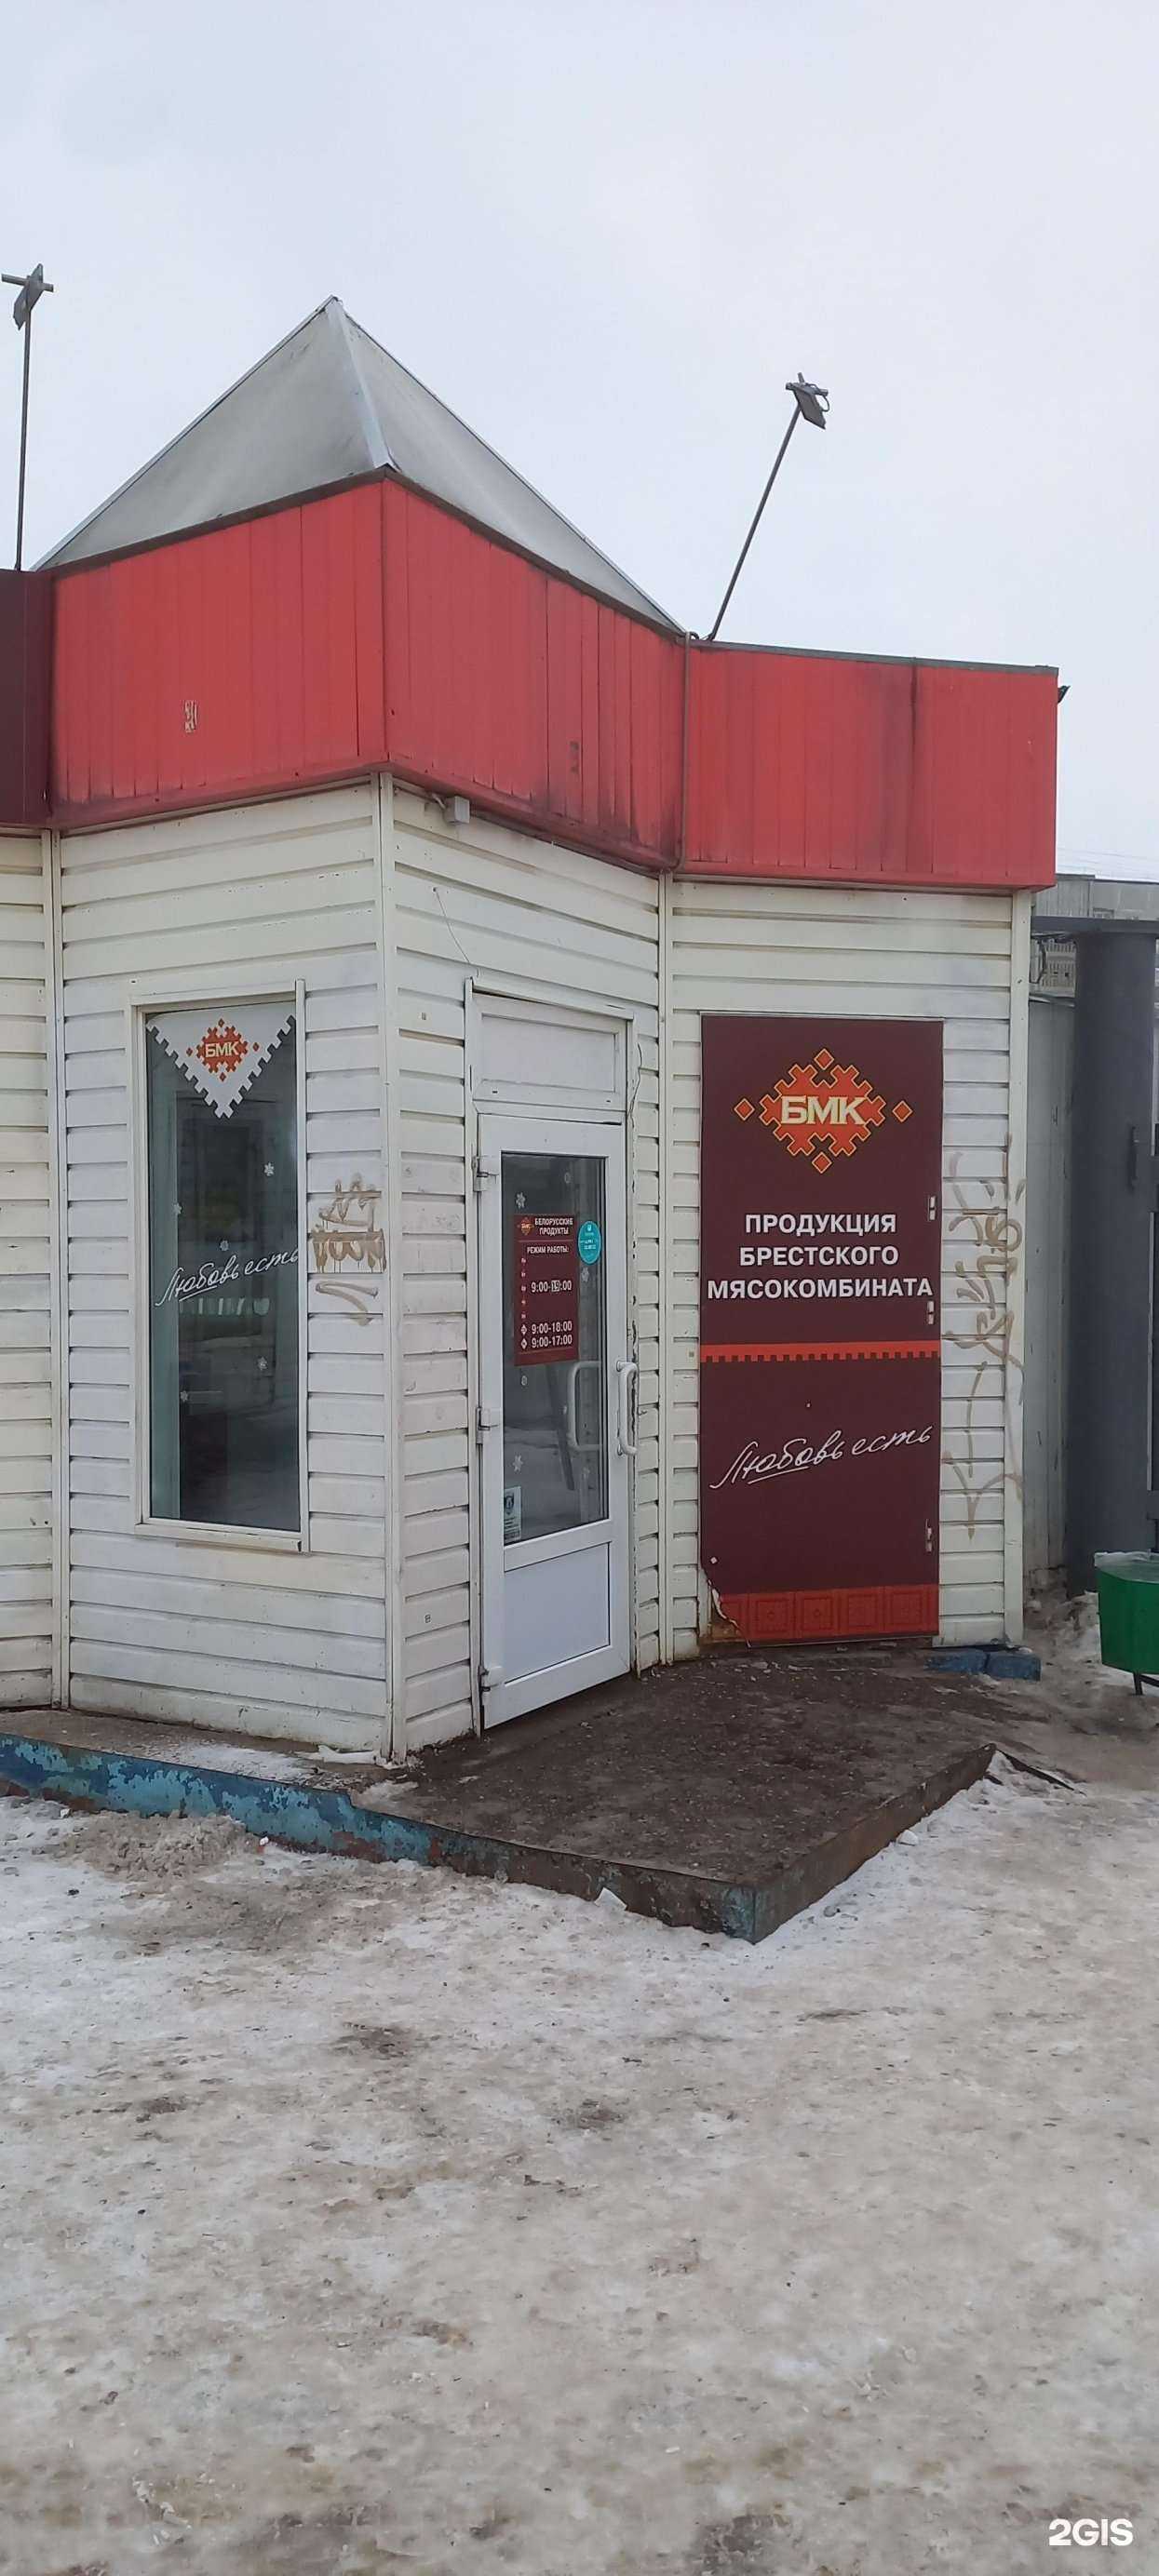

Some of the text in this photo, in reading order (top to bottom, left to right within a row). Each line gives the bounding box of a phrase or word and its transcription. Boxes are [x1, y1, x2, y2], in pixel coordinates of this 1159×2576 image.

[205, 1040, 240, 1058] БМК
[780, 1095, 867, 1125] БМК
[534, 1217, 573, 1226] БЕЛОРУССКИЕ
[539, 1227, 569, 1236] ПРОДУКТЫ
[745, 1214, 896, 1237] ПРОДУКЦИЯ
[739, 1246, 899, 1267] БРЕСТСКОГО
[155, 1248, 299, 1307] Любовь есть
[707, 1277, 934, 1299] МЯСОКОМБИНАТА
[531, 1321, 573, 1335] 9:00-18:00
[532, 1334, 573, 1348] 9:00-17:00
[709, 1426, 933, 1489] Любовь есть
